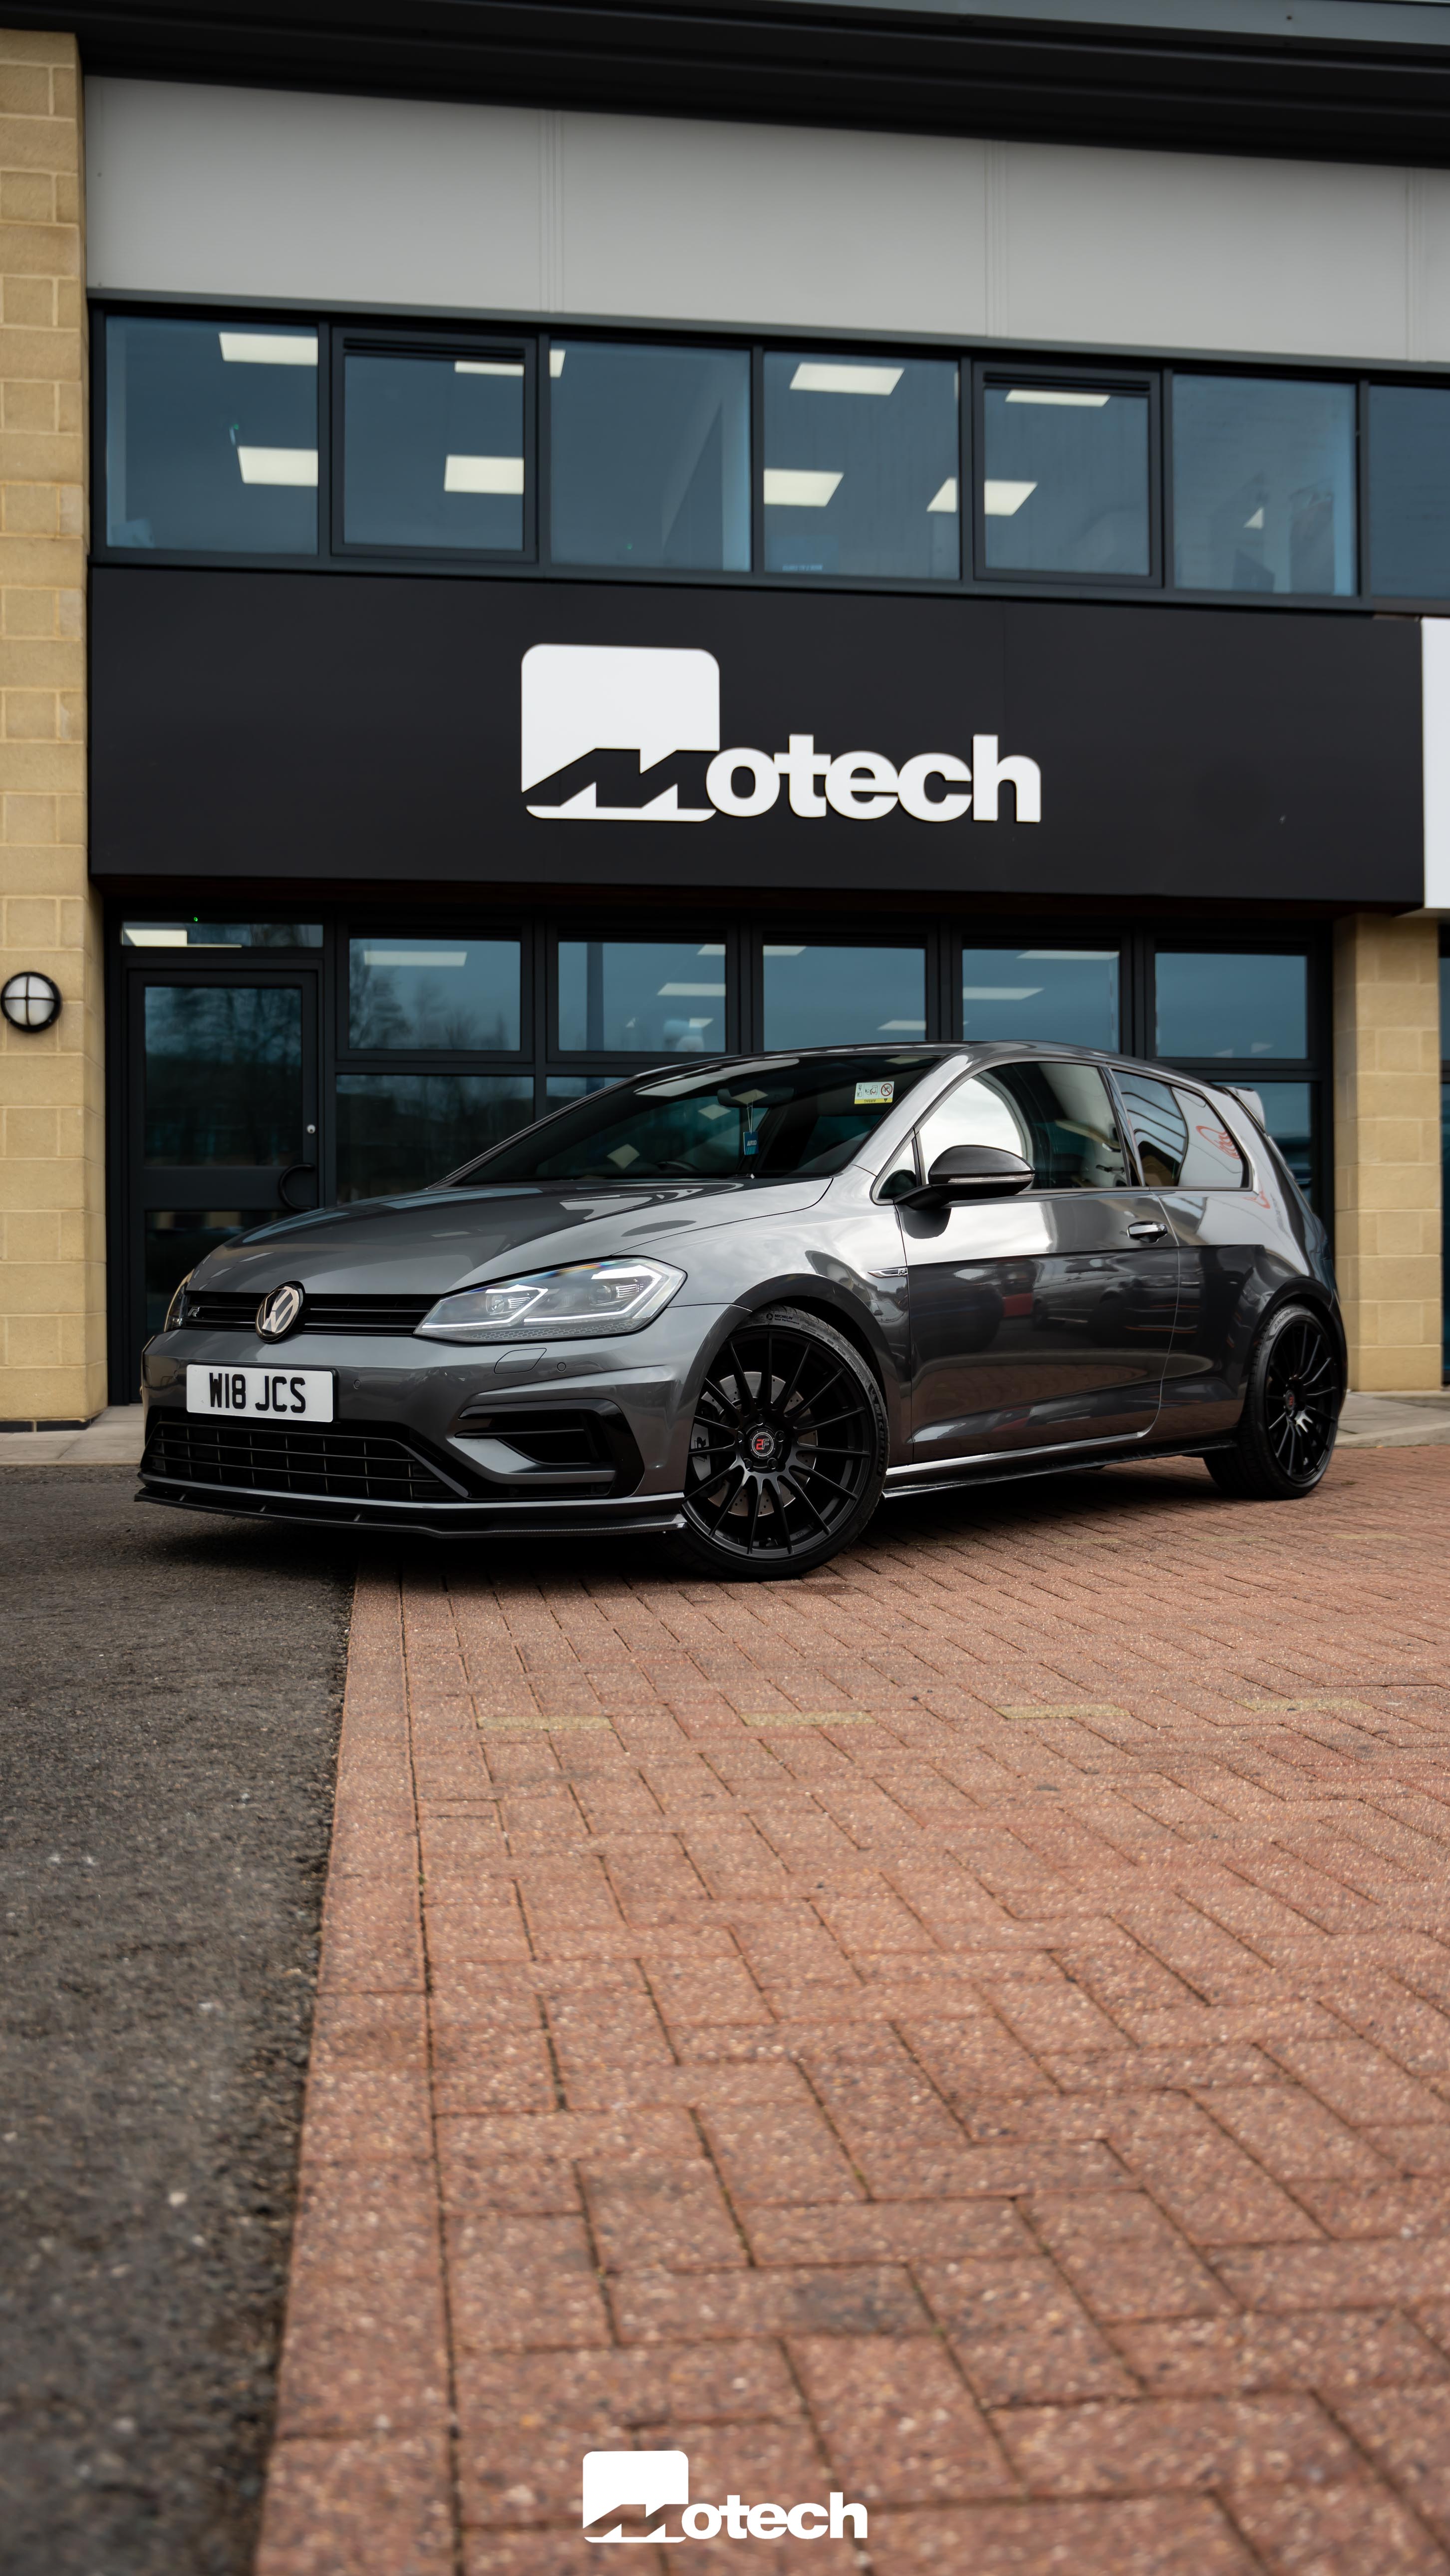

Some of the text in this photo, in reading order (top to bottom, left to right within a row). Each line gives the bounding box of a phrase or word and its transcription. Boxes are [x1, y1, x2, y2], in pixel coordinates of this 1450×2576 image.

[209, 1372, 306, 1413] W18 JCS
[874, 1403, 885, 1474] MICHELIN
